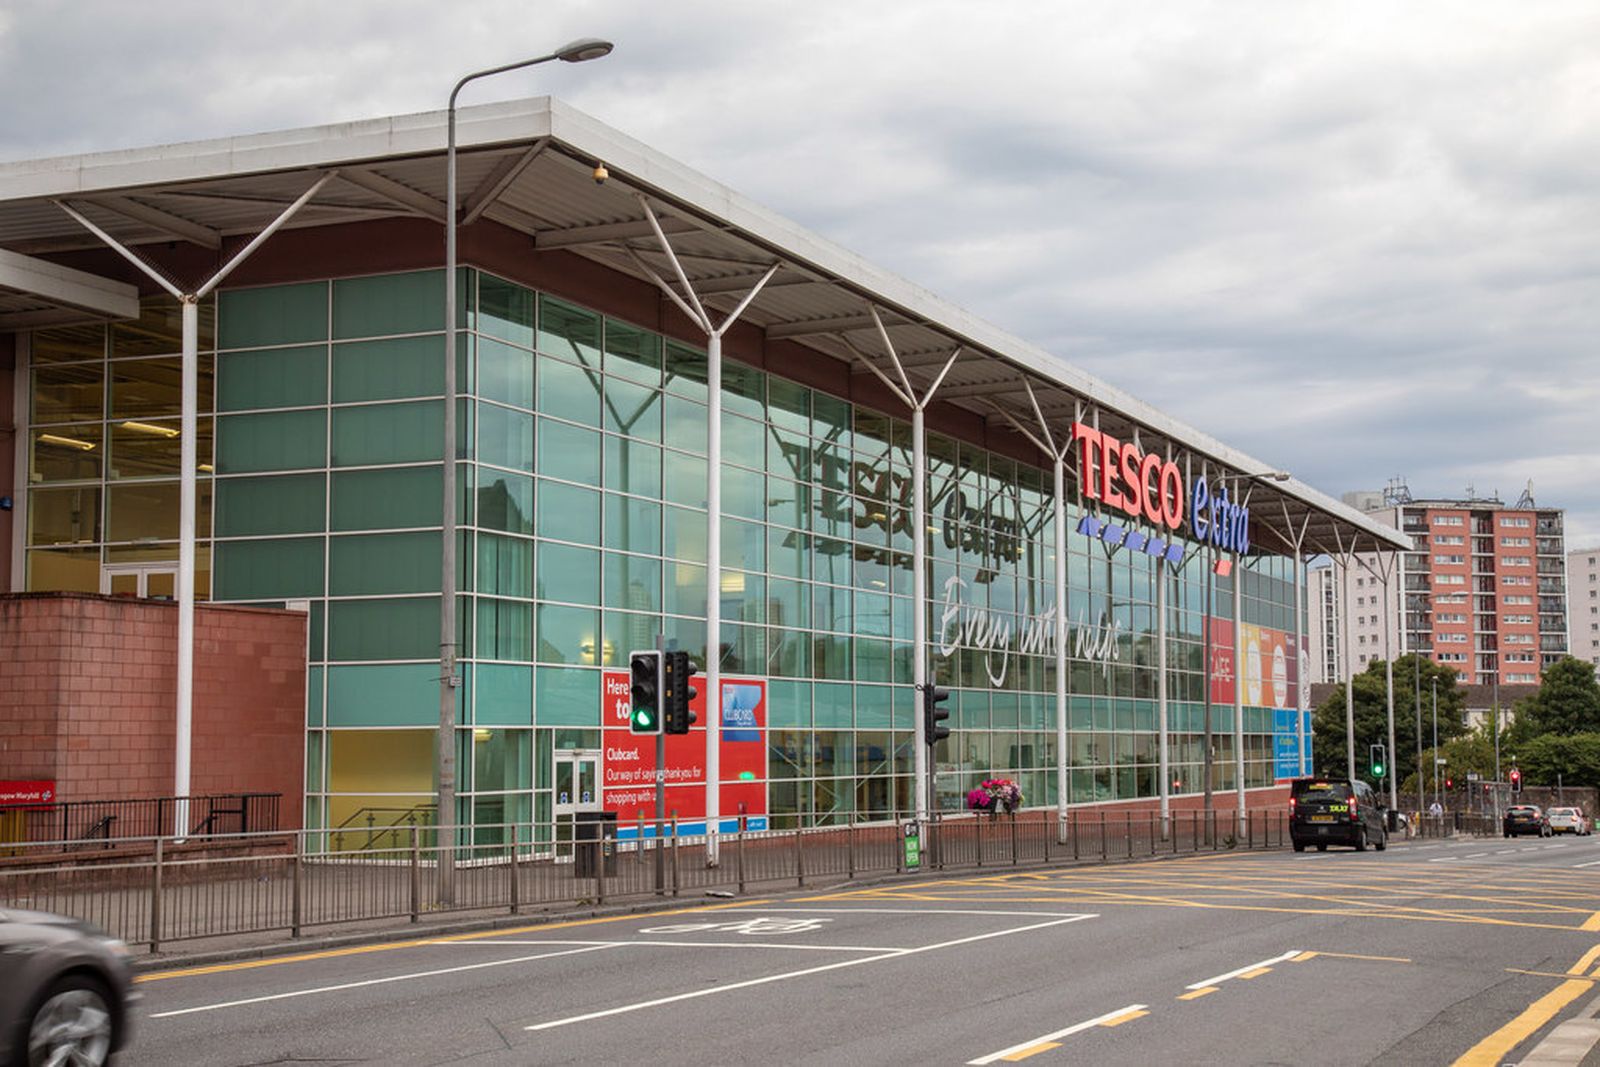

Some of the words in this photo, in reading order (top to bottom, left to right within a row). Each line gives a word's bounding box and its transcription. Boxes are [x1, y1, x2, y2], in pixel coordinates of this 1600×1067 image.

[1072, 422, 1183, 529] TESCO
[1191, 476, 1249, 555] extra
[940, 576, 1010, 688] Every
[607, 678, 629, 695] Here
[616, 698, 630, 719] to
[607, 747, 640, 760] Clubcard.
[607, 768, 619, 781] Our
[642, 767, 657, 782] sayin
